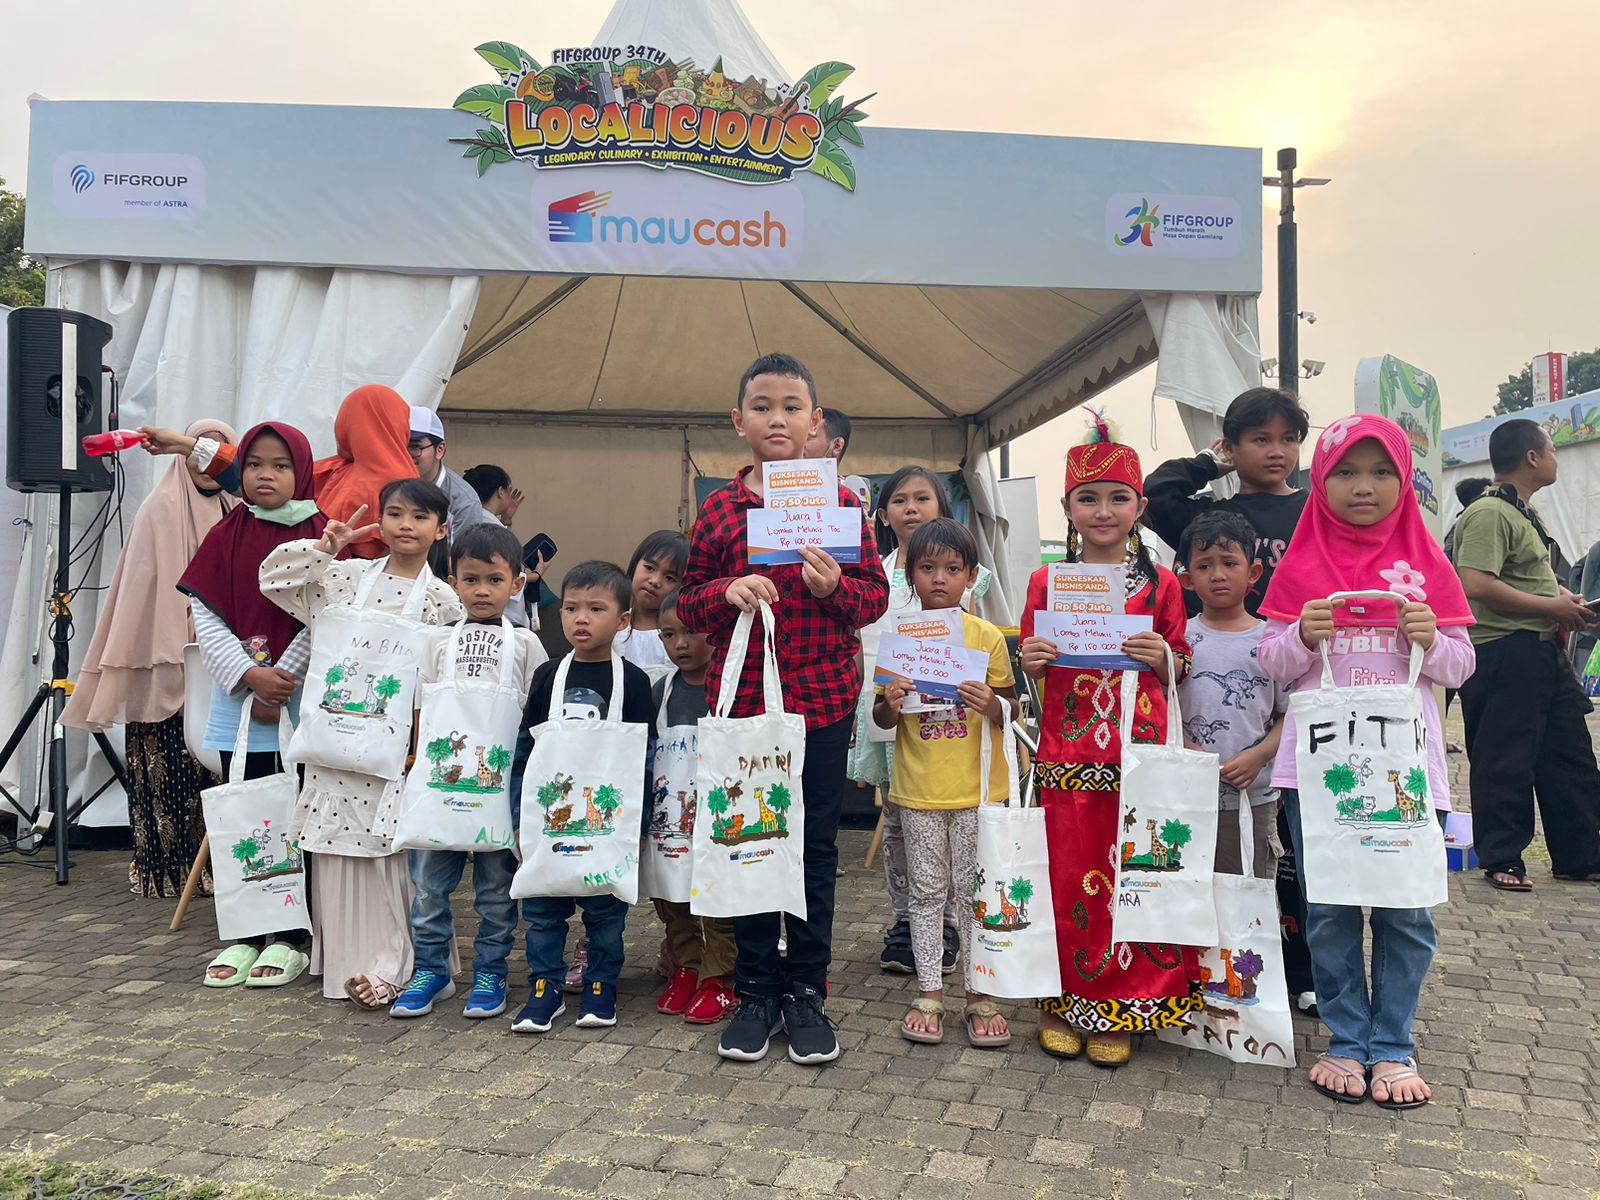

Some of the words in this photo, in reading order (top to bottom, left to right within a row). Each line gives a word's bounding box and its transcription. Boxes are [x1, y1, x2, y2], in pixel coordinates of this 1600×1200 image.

[552, 47, 621, 63] FIFGROUP
[627, 45, 666, 63] 34TH
[505, 100, 822, 159] LOCALICIOUS
[544, 151, 596, 164] LEGENDARY
[599, 150, 643, 159] CULINARY
[651, 150, 702, 162] EXHIBITION
[710, 154, 784, 175] ENTERTAINMENT
[104, 174, 188, 187] FIFGROUP
[163, 200, 188, 208] ASTRA
[1163, 214, 1234, 228] FIFGROUP
[600, 210, 786, 248] maucash
[770, 470, 818, 479] SUKSESKAN
[772, 500, 787, 508] Rp
[788, 498, 801, 506] 50
[801, 497, 827, 505] Juta
[781, 509, 811, 523] Juara
[827, 525, 841, 533] Tas
[780, 538, 790, 548] Rp
[1056, 574, 1105, 582] SUKSESKAN
[1055, 603, 1069, 611] Rp
[1086, 603, 1112, 611] Juta
[899, 621, 944, 631] SUKSESKAN
[1072, 614, 1097, 626] Juara
[458, 630, 503, 648] BOSTON
[915, 640, 940, 655] Juara
[1068, 643, 1079, 652] Rp
[467, 663, 482, 677] 92
[902, 663, 914, 674] Rp
[919, 666, 930, 675] 50
[951, 660, 965, 670] Tas
